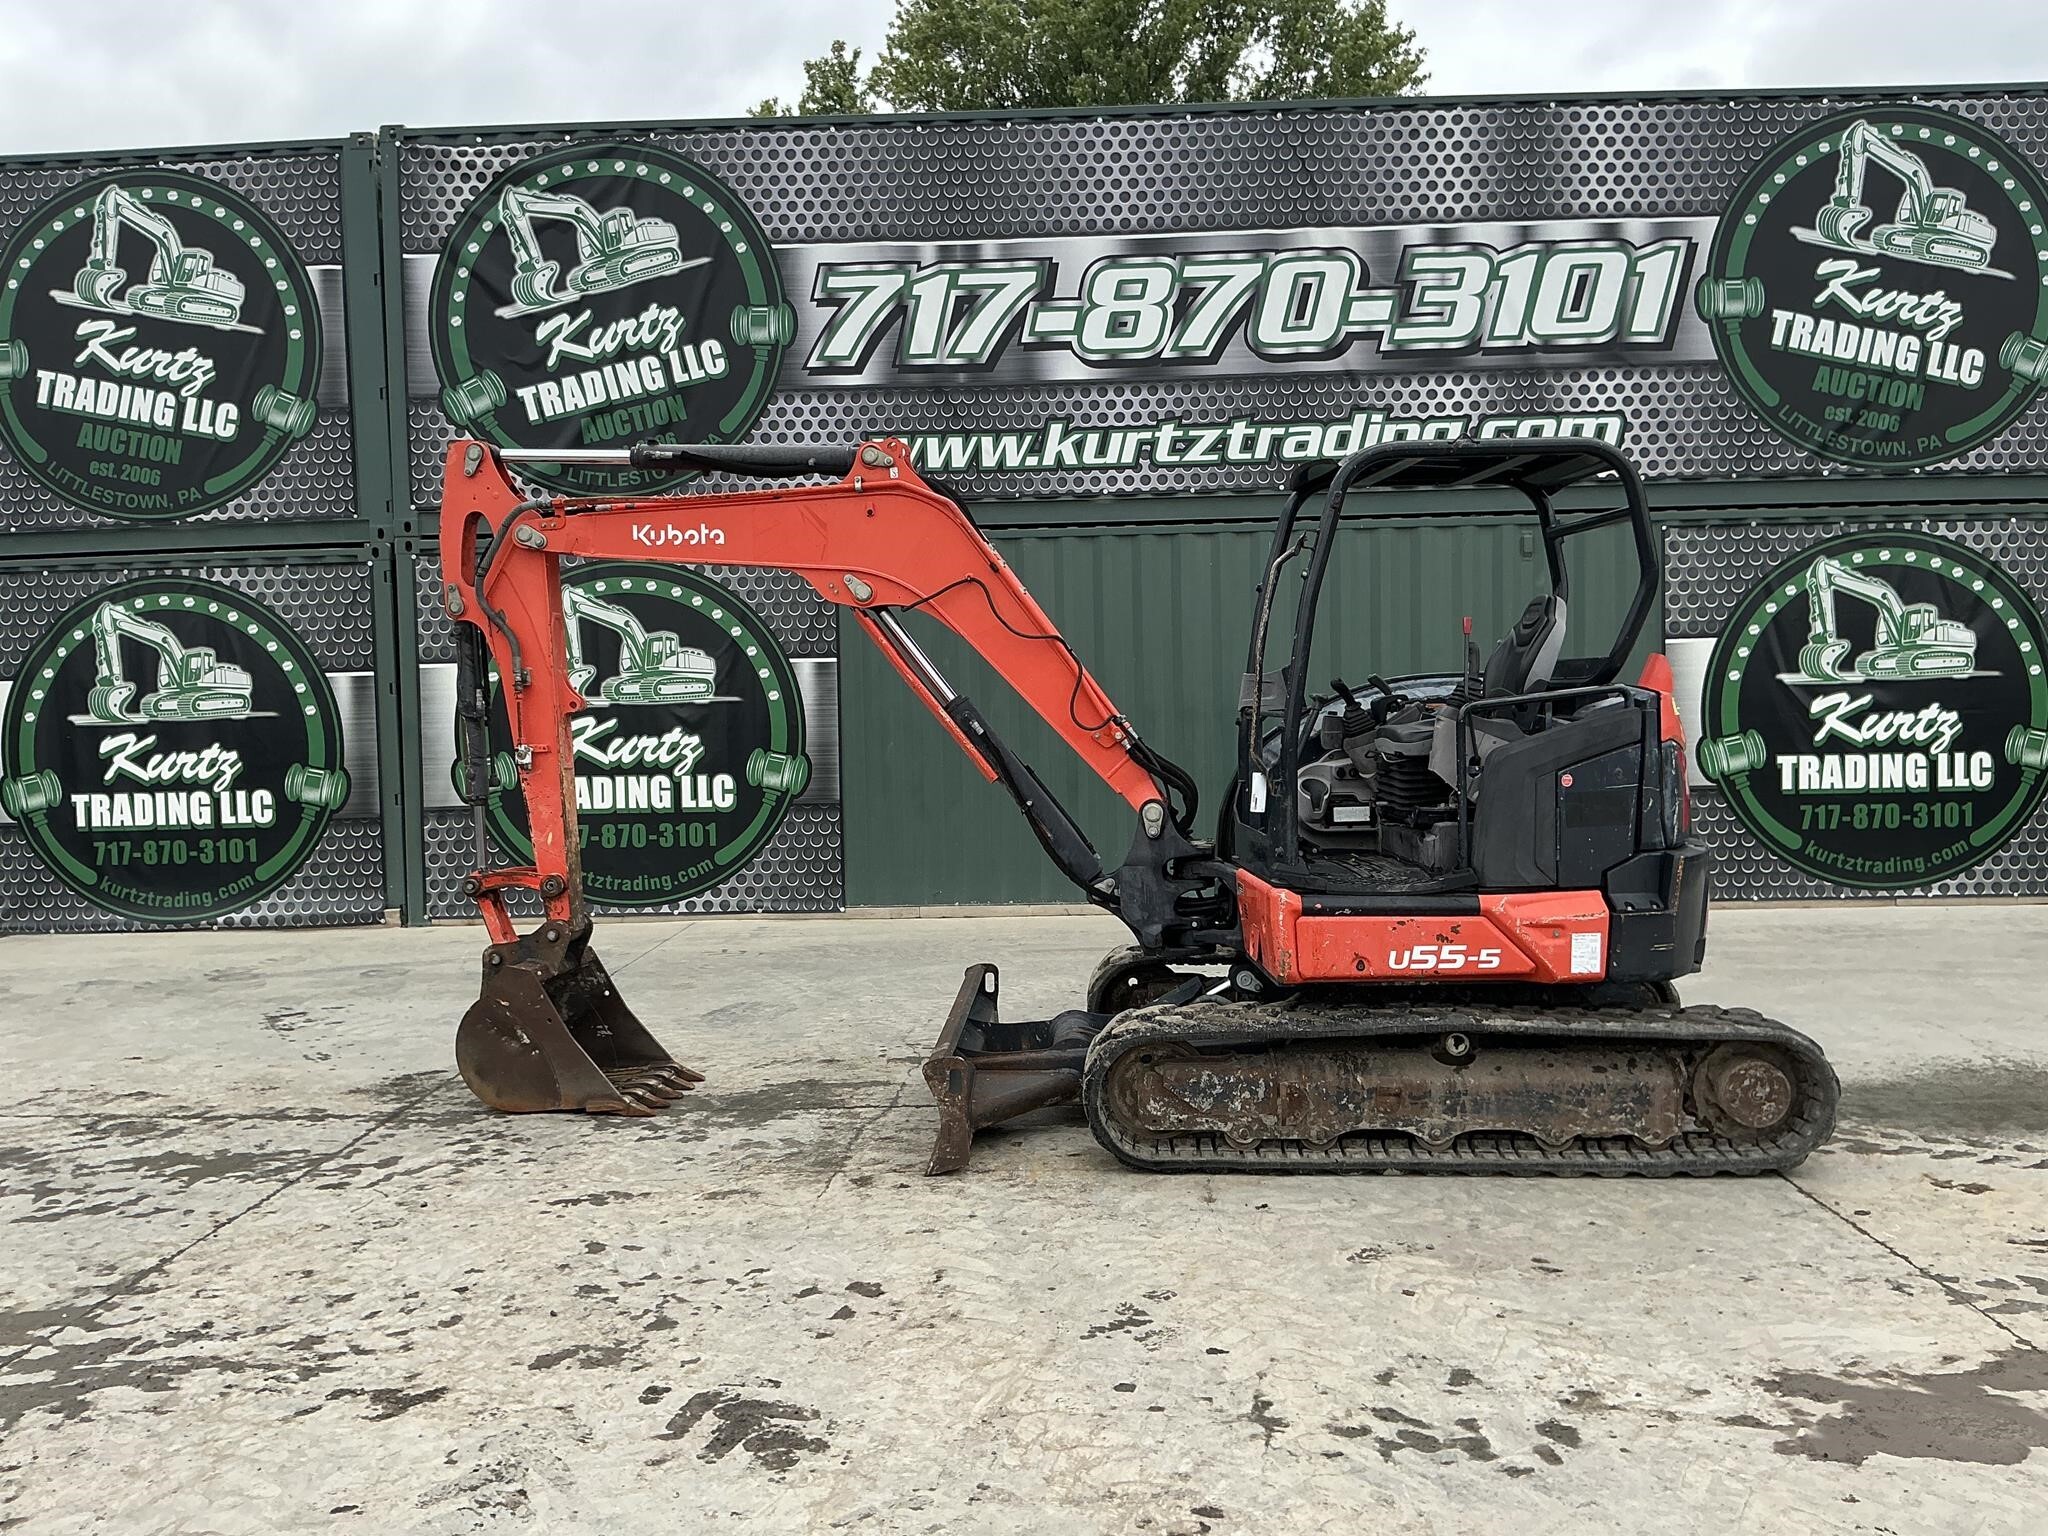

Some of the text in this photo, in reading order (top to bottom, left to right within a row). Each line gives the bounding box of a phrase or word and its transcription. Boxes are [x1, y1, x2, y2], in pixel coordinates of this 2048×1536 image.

[811, 243, 1688, 368] 717-870-3101
[1812, 258, 1962, 341] Kurtz
[75, 320, 216, 396] Kurtz
[535, 303, 684, 371] Kurtz
[1770, 309, 1986, 388] TRADING LLC
[517, 339, 728, 424] TRADING LLC
[1812, 366, 1925, 411] AUCTION
[36, 370, 240, 440] TRADING LLC
[580, 395, 688, 445] AUCTION
[1824, 405, 1900, 433] est. 2006
[76, 423, 182, 465] AUCTION
[872, 412, 1625, 470] ww.kurtztradincom
[1778, 404, 1942, 457] LITTLESTOWN, PA
[47, 460, 201, 510] LITTLESTOWN, PA
[89, 460, 161, 486] est. 2006
[567, 467, 667, 488] LITTLESTO
[632, 523, 725, 546] Kubota
[1809, 692, 1962, 754] Kurtz
[99, 733, 243, 791] Kurtz
[571, 716, 705, 777] Kurtz
[575, 773, 737, 813] ADING LLC
[1776, 751, 1994, 793] TRADING LLC
[71, 789, 276, 831] TRADING LLC
[1800, 802, 1973, 830] 717-870-3101
[93, 838, 258, 866] 717-870-3101
[578, 822, 717, 849] 7-870-3101
[1804, 839, 1968, 874] kurtztrading.com
[100, 876, 255, 909] kurtztrading.com
[581, 858, 714, 892] rtztrading.com
